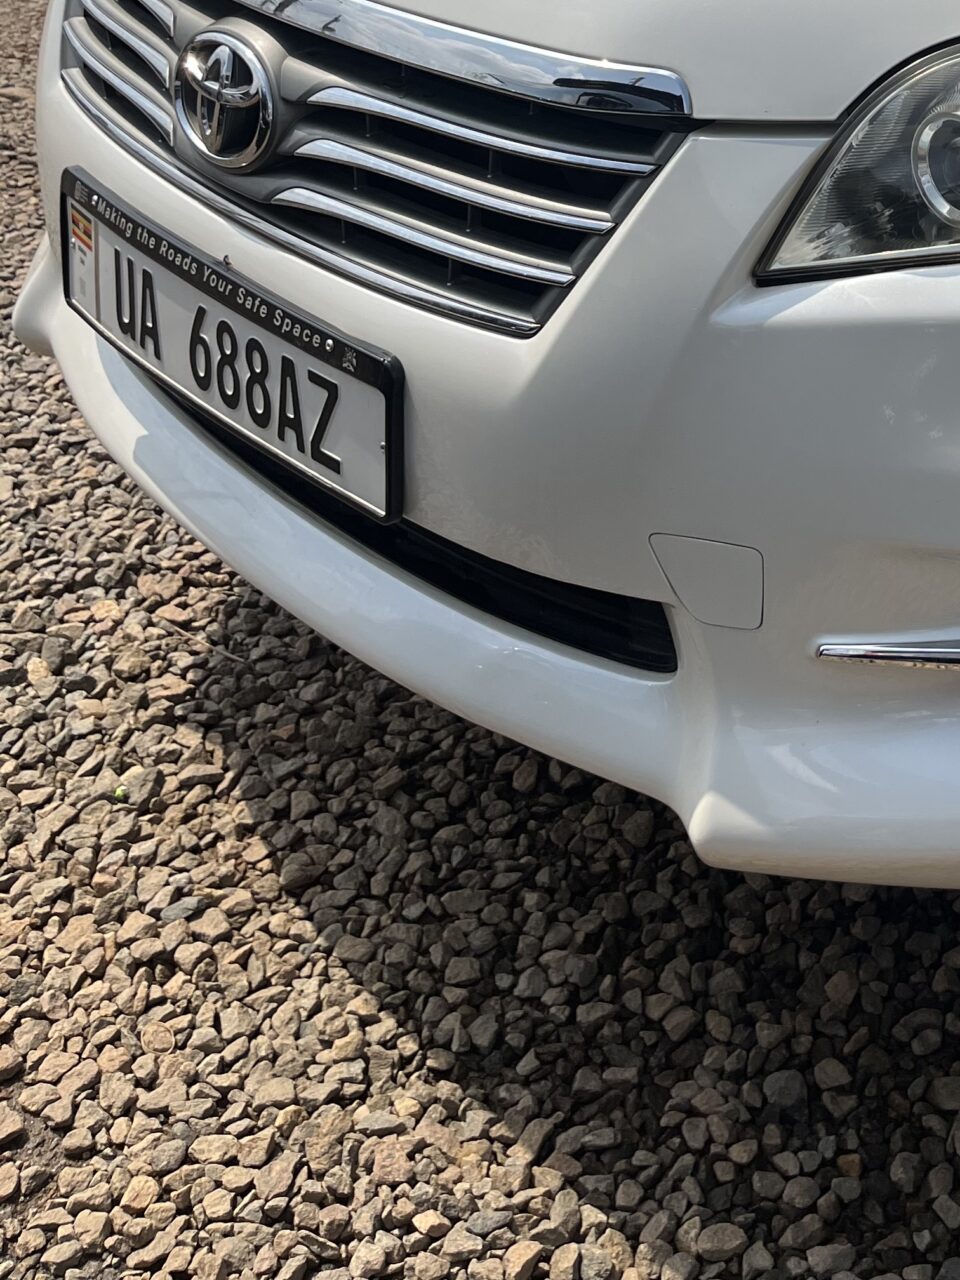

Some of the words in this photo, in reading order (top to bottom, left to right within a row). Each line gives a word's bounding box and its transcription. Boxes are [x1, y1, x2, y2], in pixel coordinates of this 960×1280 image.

[97, 198, 134, 238] Making
[136, 224, 156, 250] the
[159, 243, 198, 275] Roads
[202, 265, 233, 296] Your
[236, 287, 268, 318] Safe
[273, 309, 322, 348] Space
[113, 246, 162, 362] UA
[189, 304, 342, 476] 688AZ
